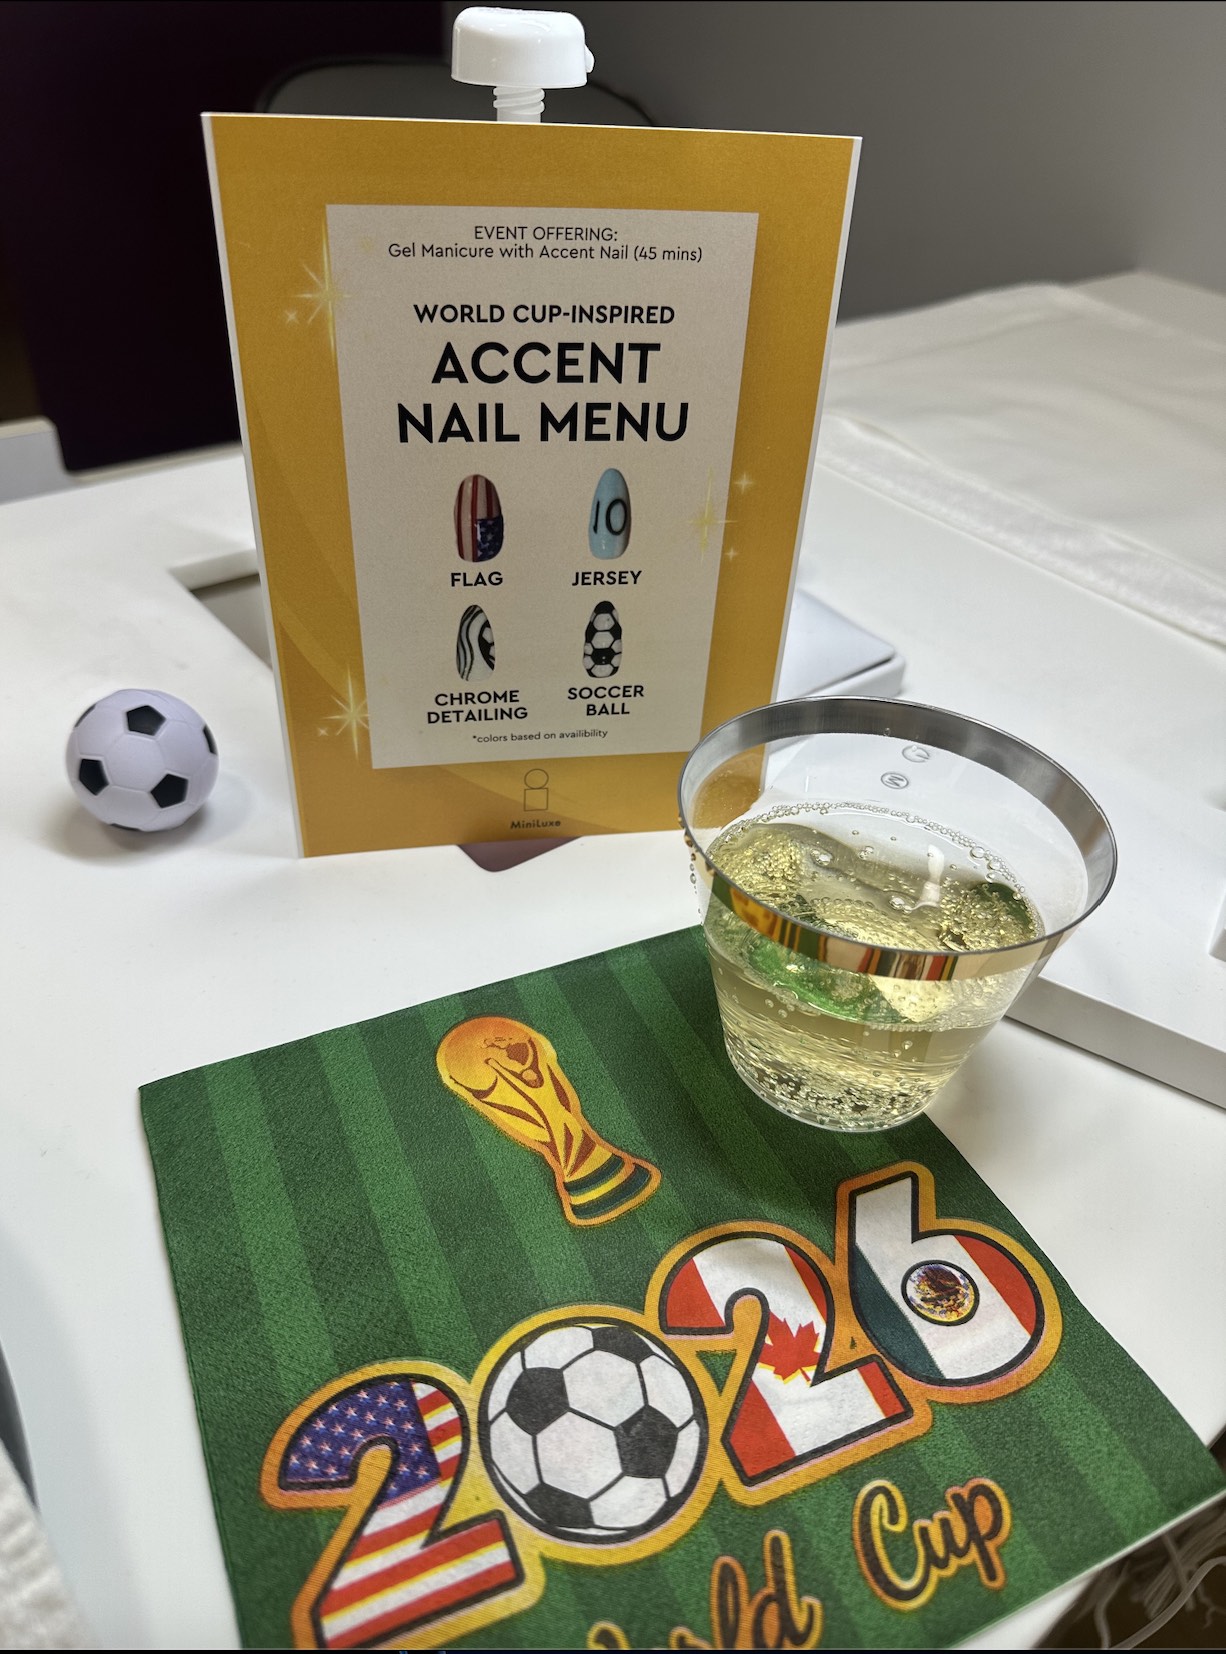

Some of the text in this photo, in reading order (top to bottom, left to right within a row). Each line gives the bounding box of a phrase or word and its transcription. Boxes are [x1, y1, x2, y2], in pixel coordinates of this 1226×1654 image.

[474, 225, 618, 243] EVENT OFFERING:
[388, 241, 703, 263] Gel Manicure with Accent Nail (45 mins)
[413, 304, 675, 325] WORLD CUP-INSPIRED
[431, 341, 661, 385] ACCENT
[397, 401, 689, 444] NAIL MENU
[592, 497, 629, 536] 10
[450, 571, 504, 588] FLAG
[571, 570, 643, 587] JERSEY
[434, 689, 520, 706] CHROME
[567, 684, 645, 701] SOCCER
[426, 706, 529, 724] DETAILING
[585, 703, 631, 717] BALL
[510, 731, 541, 742] based
[543, 732, 557, 740] on
[558, 729, 609, 739] availibility
[510, 818, 562, 830] MiniLuxe
[854, 1477, 1012, 1611] Cup
